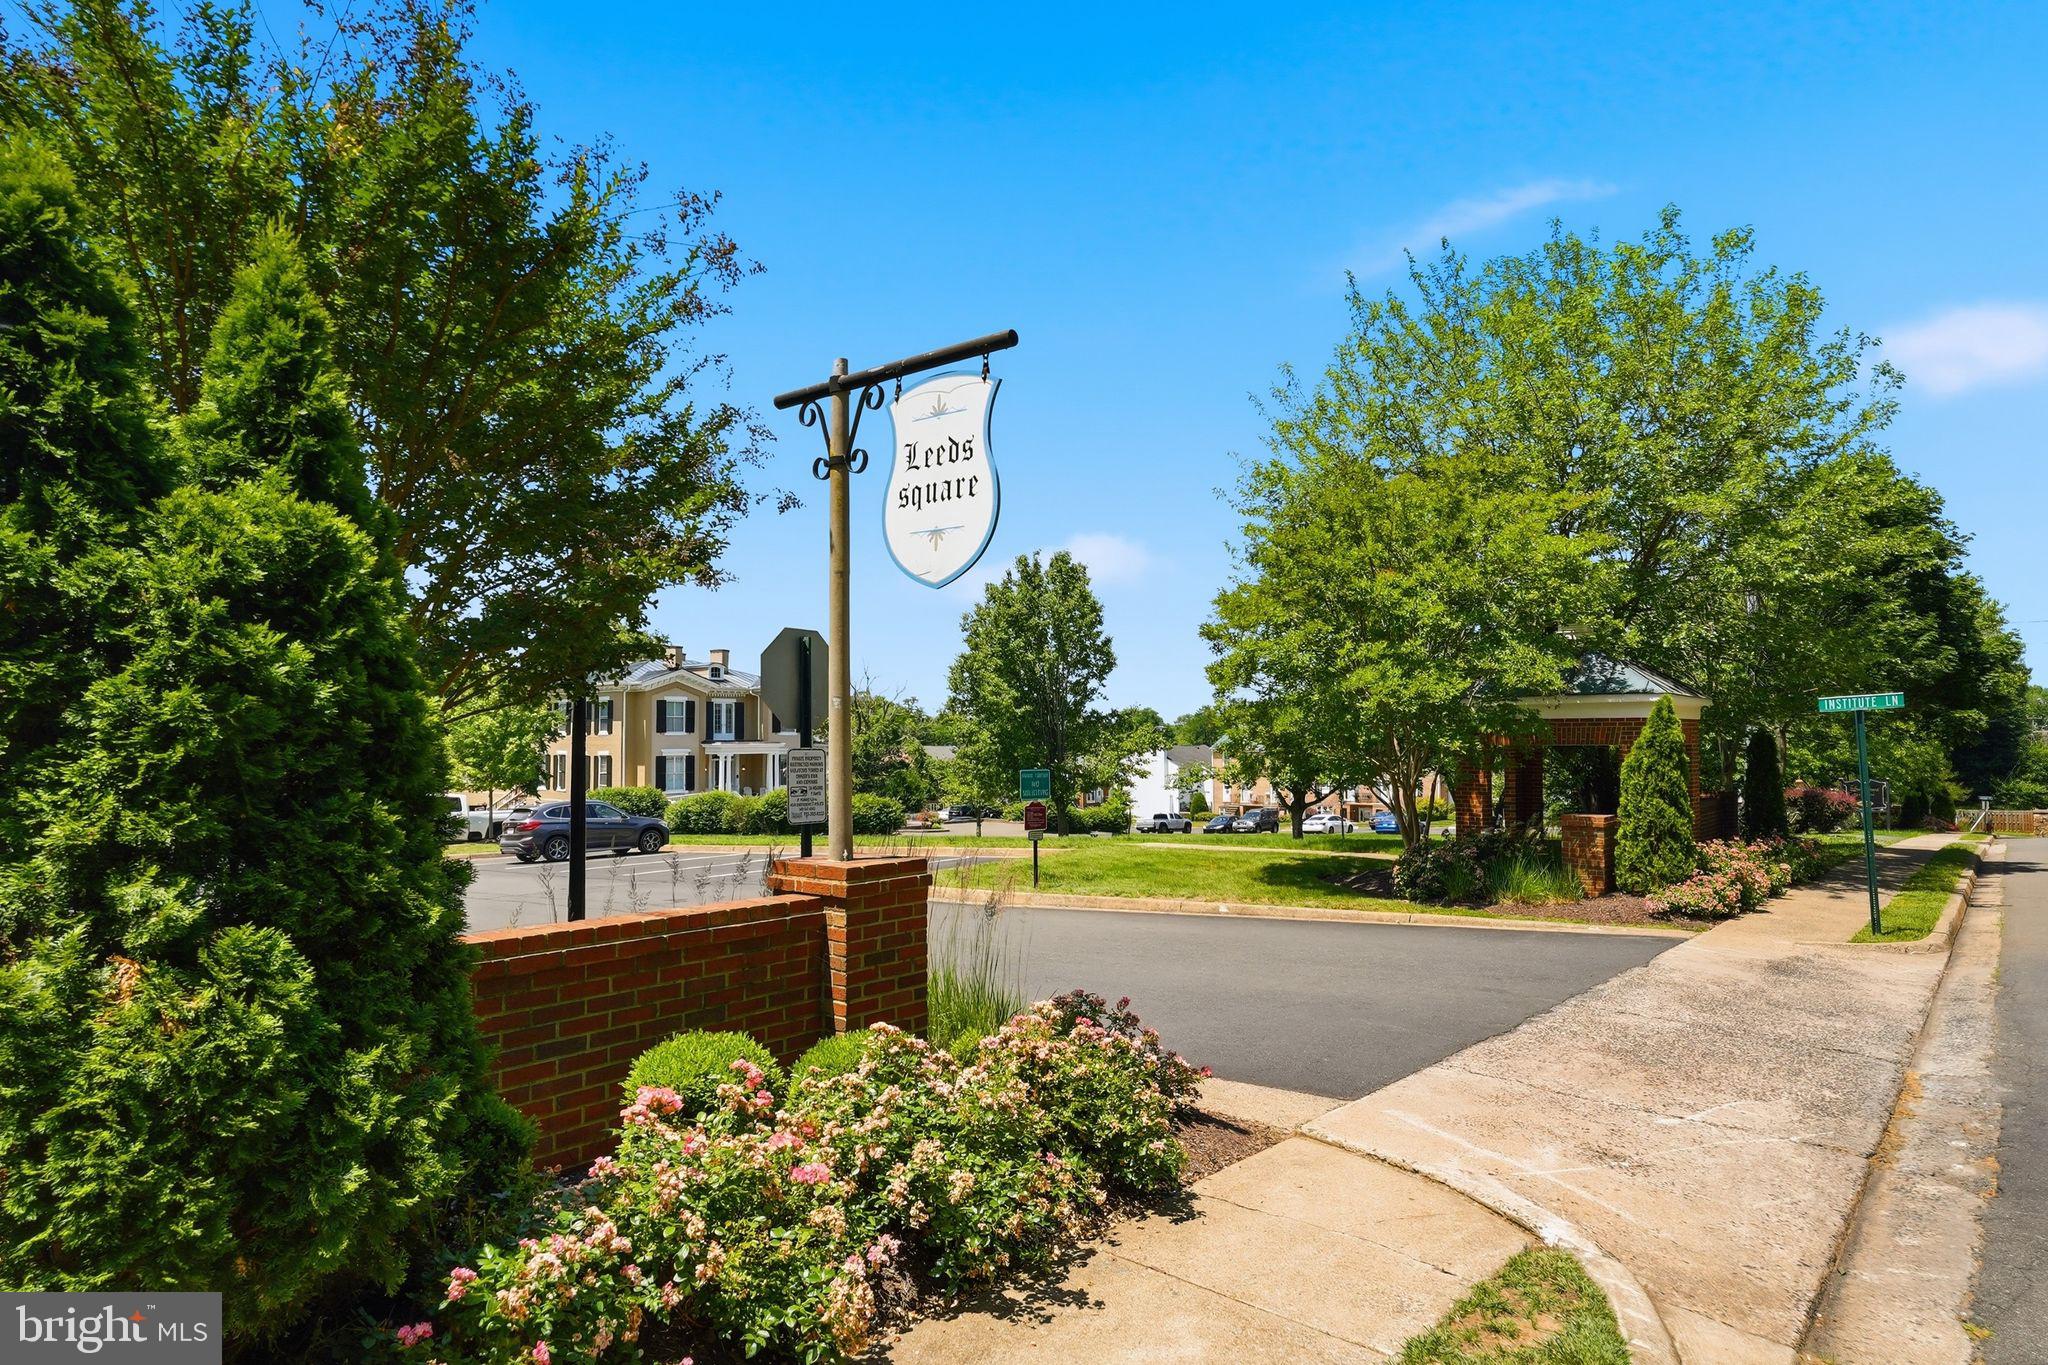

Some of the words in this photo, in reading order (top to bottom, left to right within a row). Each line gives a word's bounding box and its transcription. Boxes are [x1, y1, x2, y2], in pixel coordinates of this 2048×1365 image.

[904, 434, 974, 472] Leeds
[898, 475, 978, 512] square
[1825, 696, 1877, 710] INSTITUTE
[1885, 695, 1898, 706] LN
